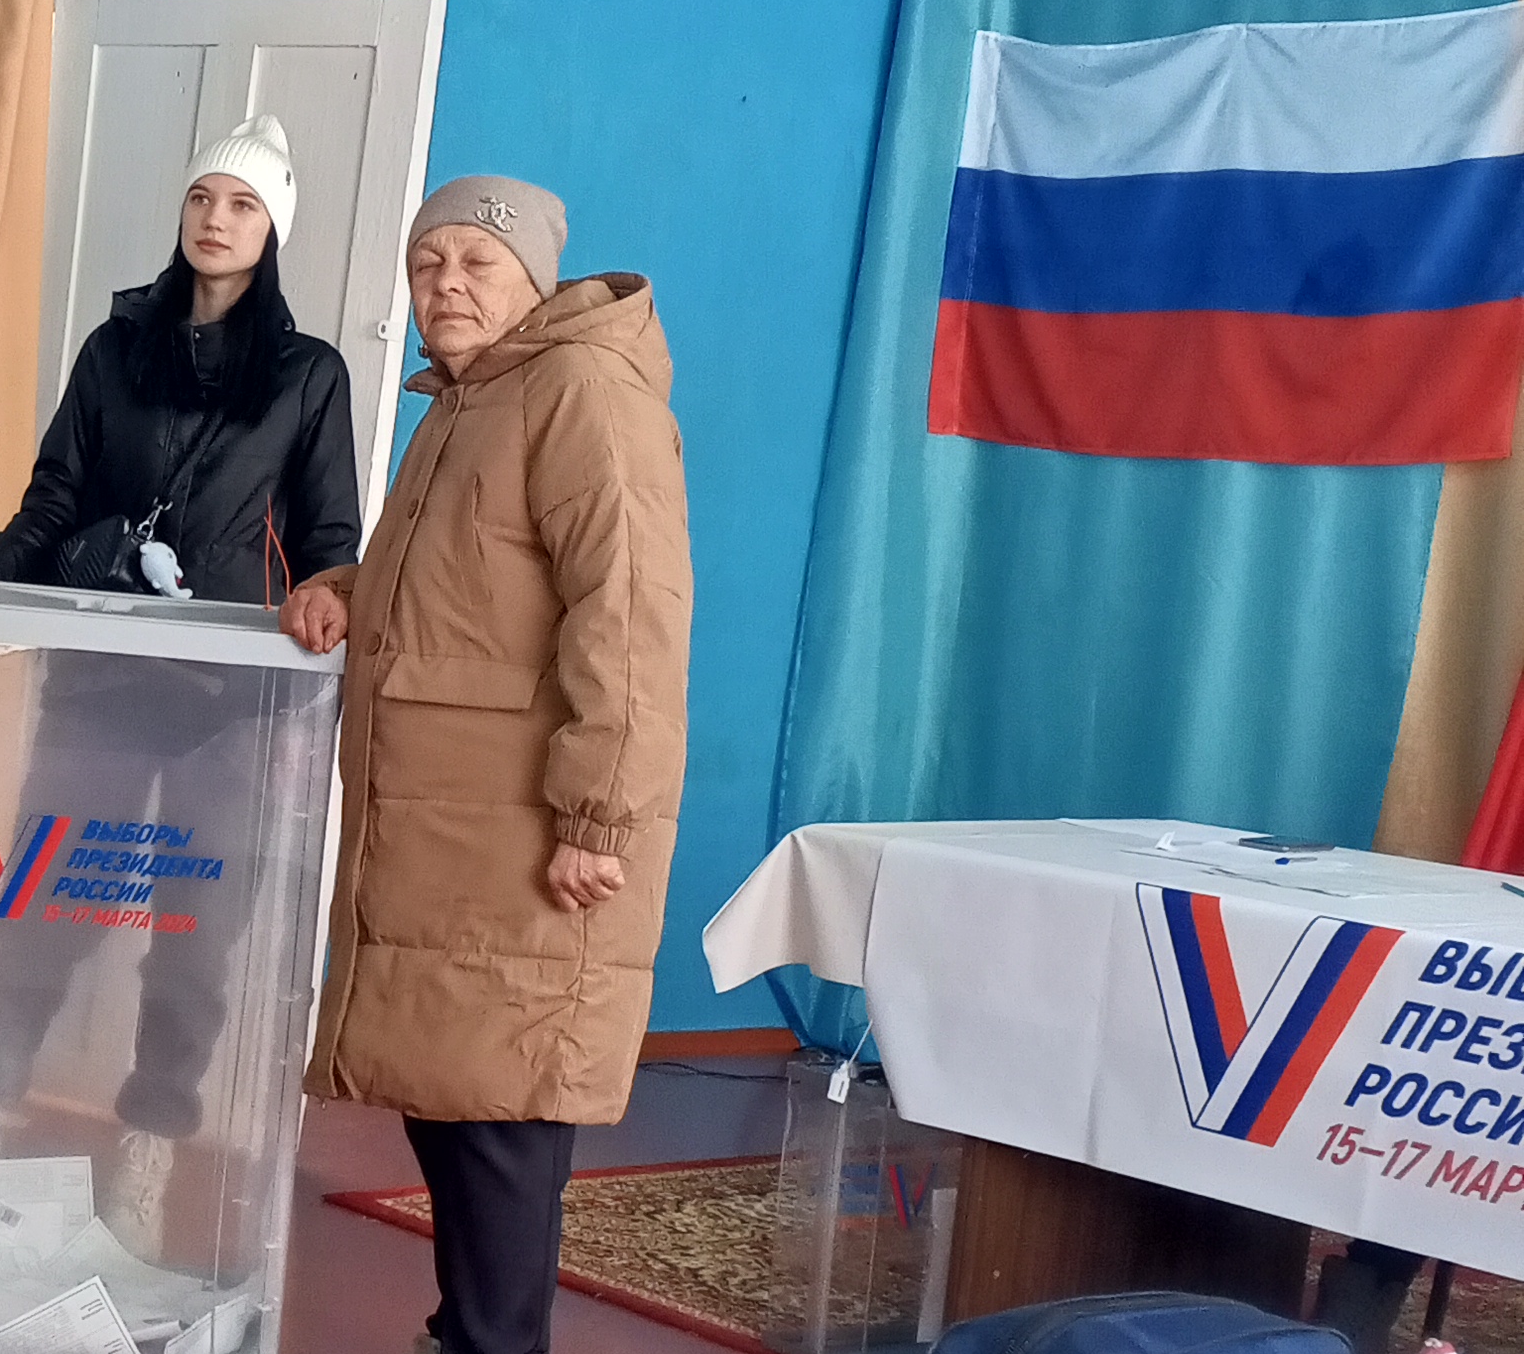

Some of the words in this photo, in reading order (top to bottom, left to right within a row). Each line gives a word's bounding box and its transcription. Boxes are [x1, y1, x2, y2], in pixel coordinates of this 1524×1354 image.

[81, 819, 194, 848] ВЫБОРЫ
[66, 847, 224, 880] ПРЕЗИДЕНТА
[52, 876, 155, 904] РОССИИ
[91, 908, 153, 930] МАРТА
[1381, 1000, 1524, 1075] ПРЕЗ
[1425, 1150, 1524, 1211] МАР
